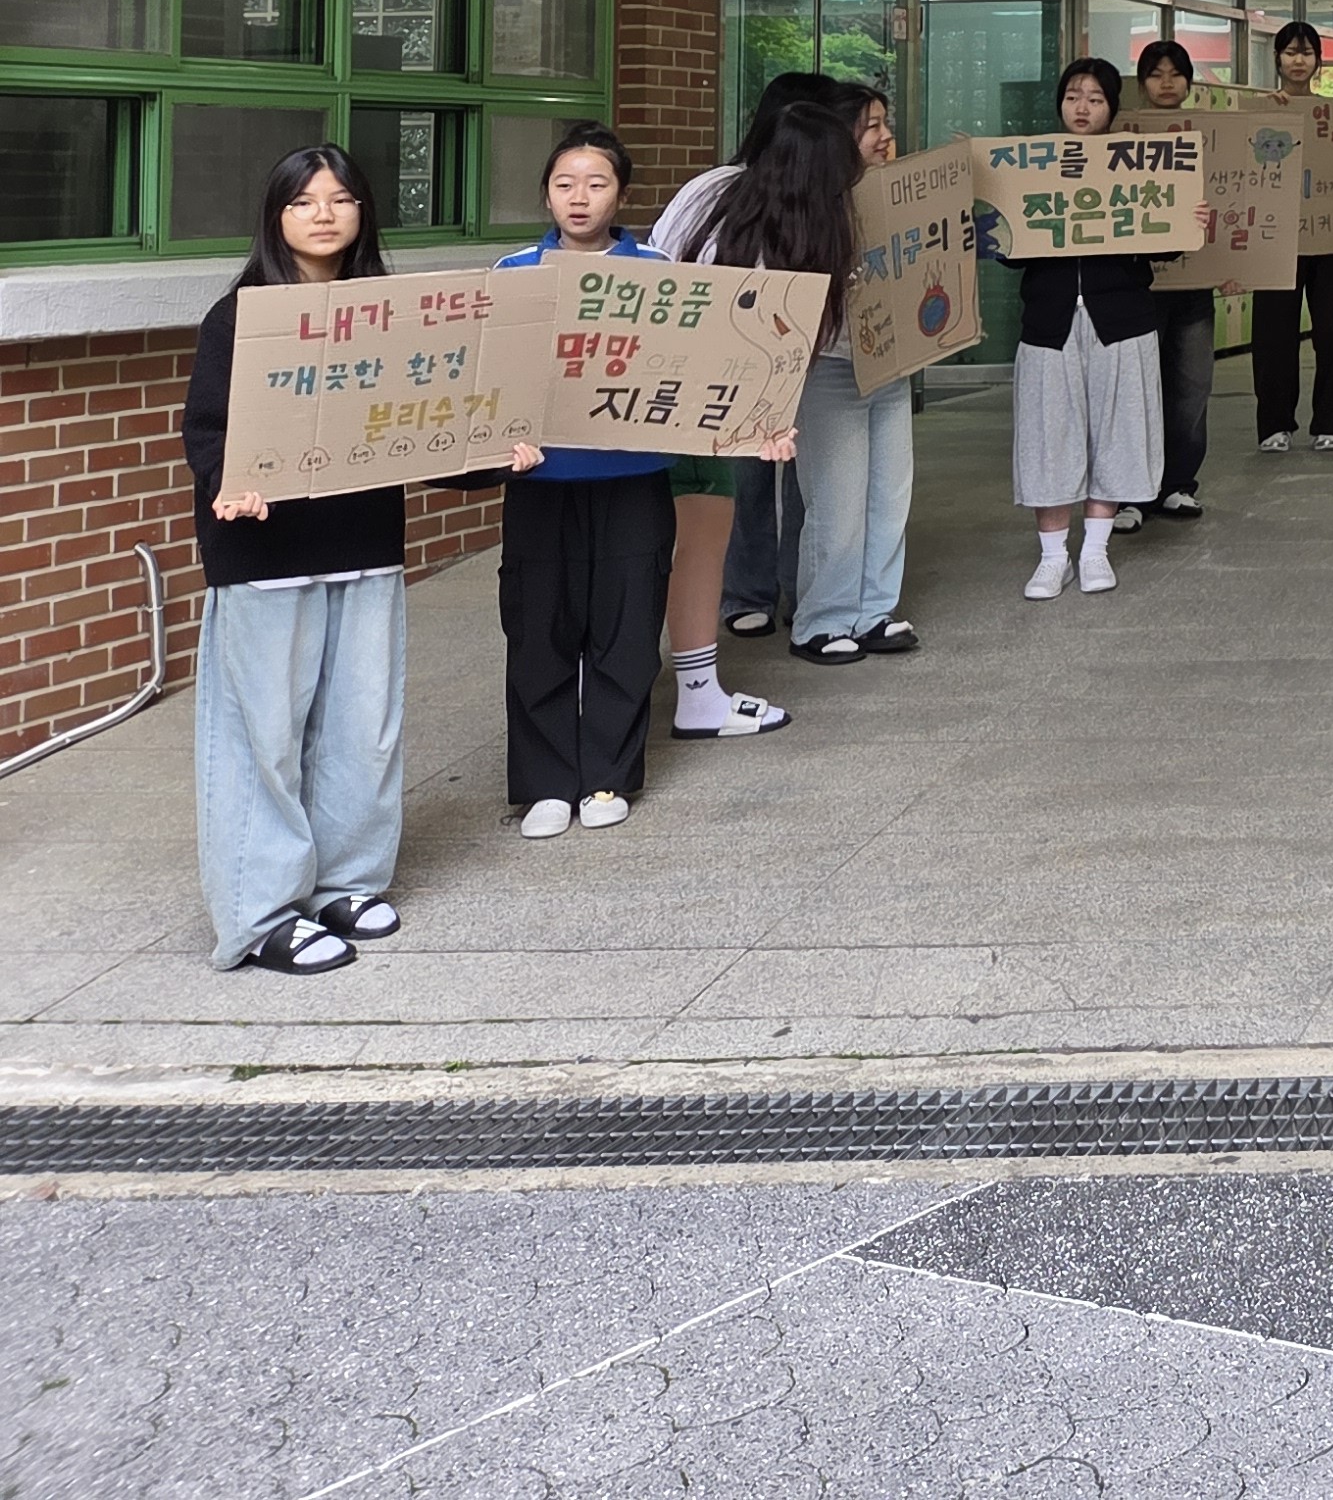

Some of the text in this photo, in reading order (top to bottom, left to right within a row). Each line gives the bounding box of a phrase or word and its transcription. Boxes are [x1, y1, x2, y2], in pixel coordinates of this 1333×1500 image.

[989, 140, 1089, 179] 지구를
[1106, 135, 1199, 173] 지키는
[1209, 168, 1283, 196] 생각하면
[863, 217, 949, 285] 지구의
[299, 289, 494, 343] 내가 만드는
[577, 271, 713, 329] 일회용품
[267, 345, 468, 396] 깨끗한 환경
[364, 387, 501, 443] 분리수거
